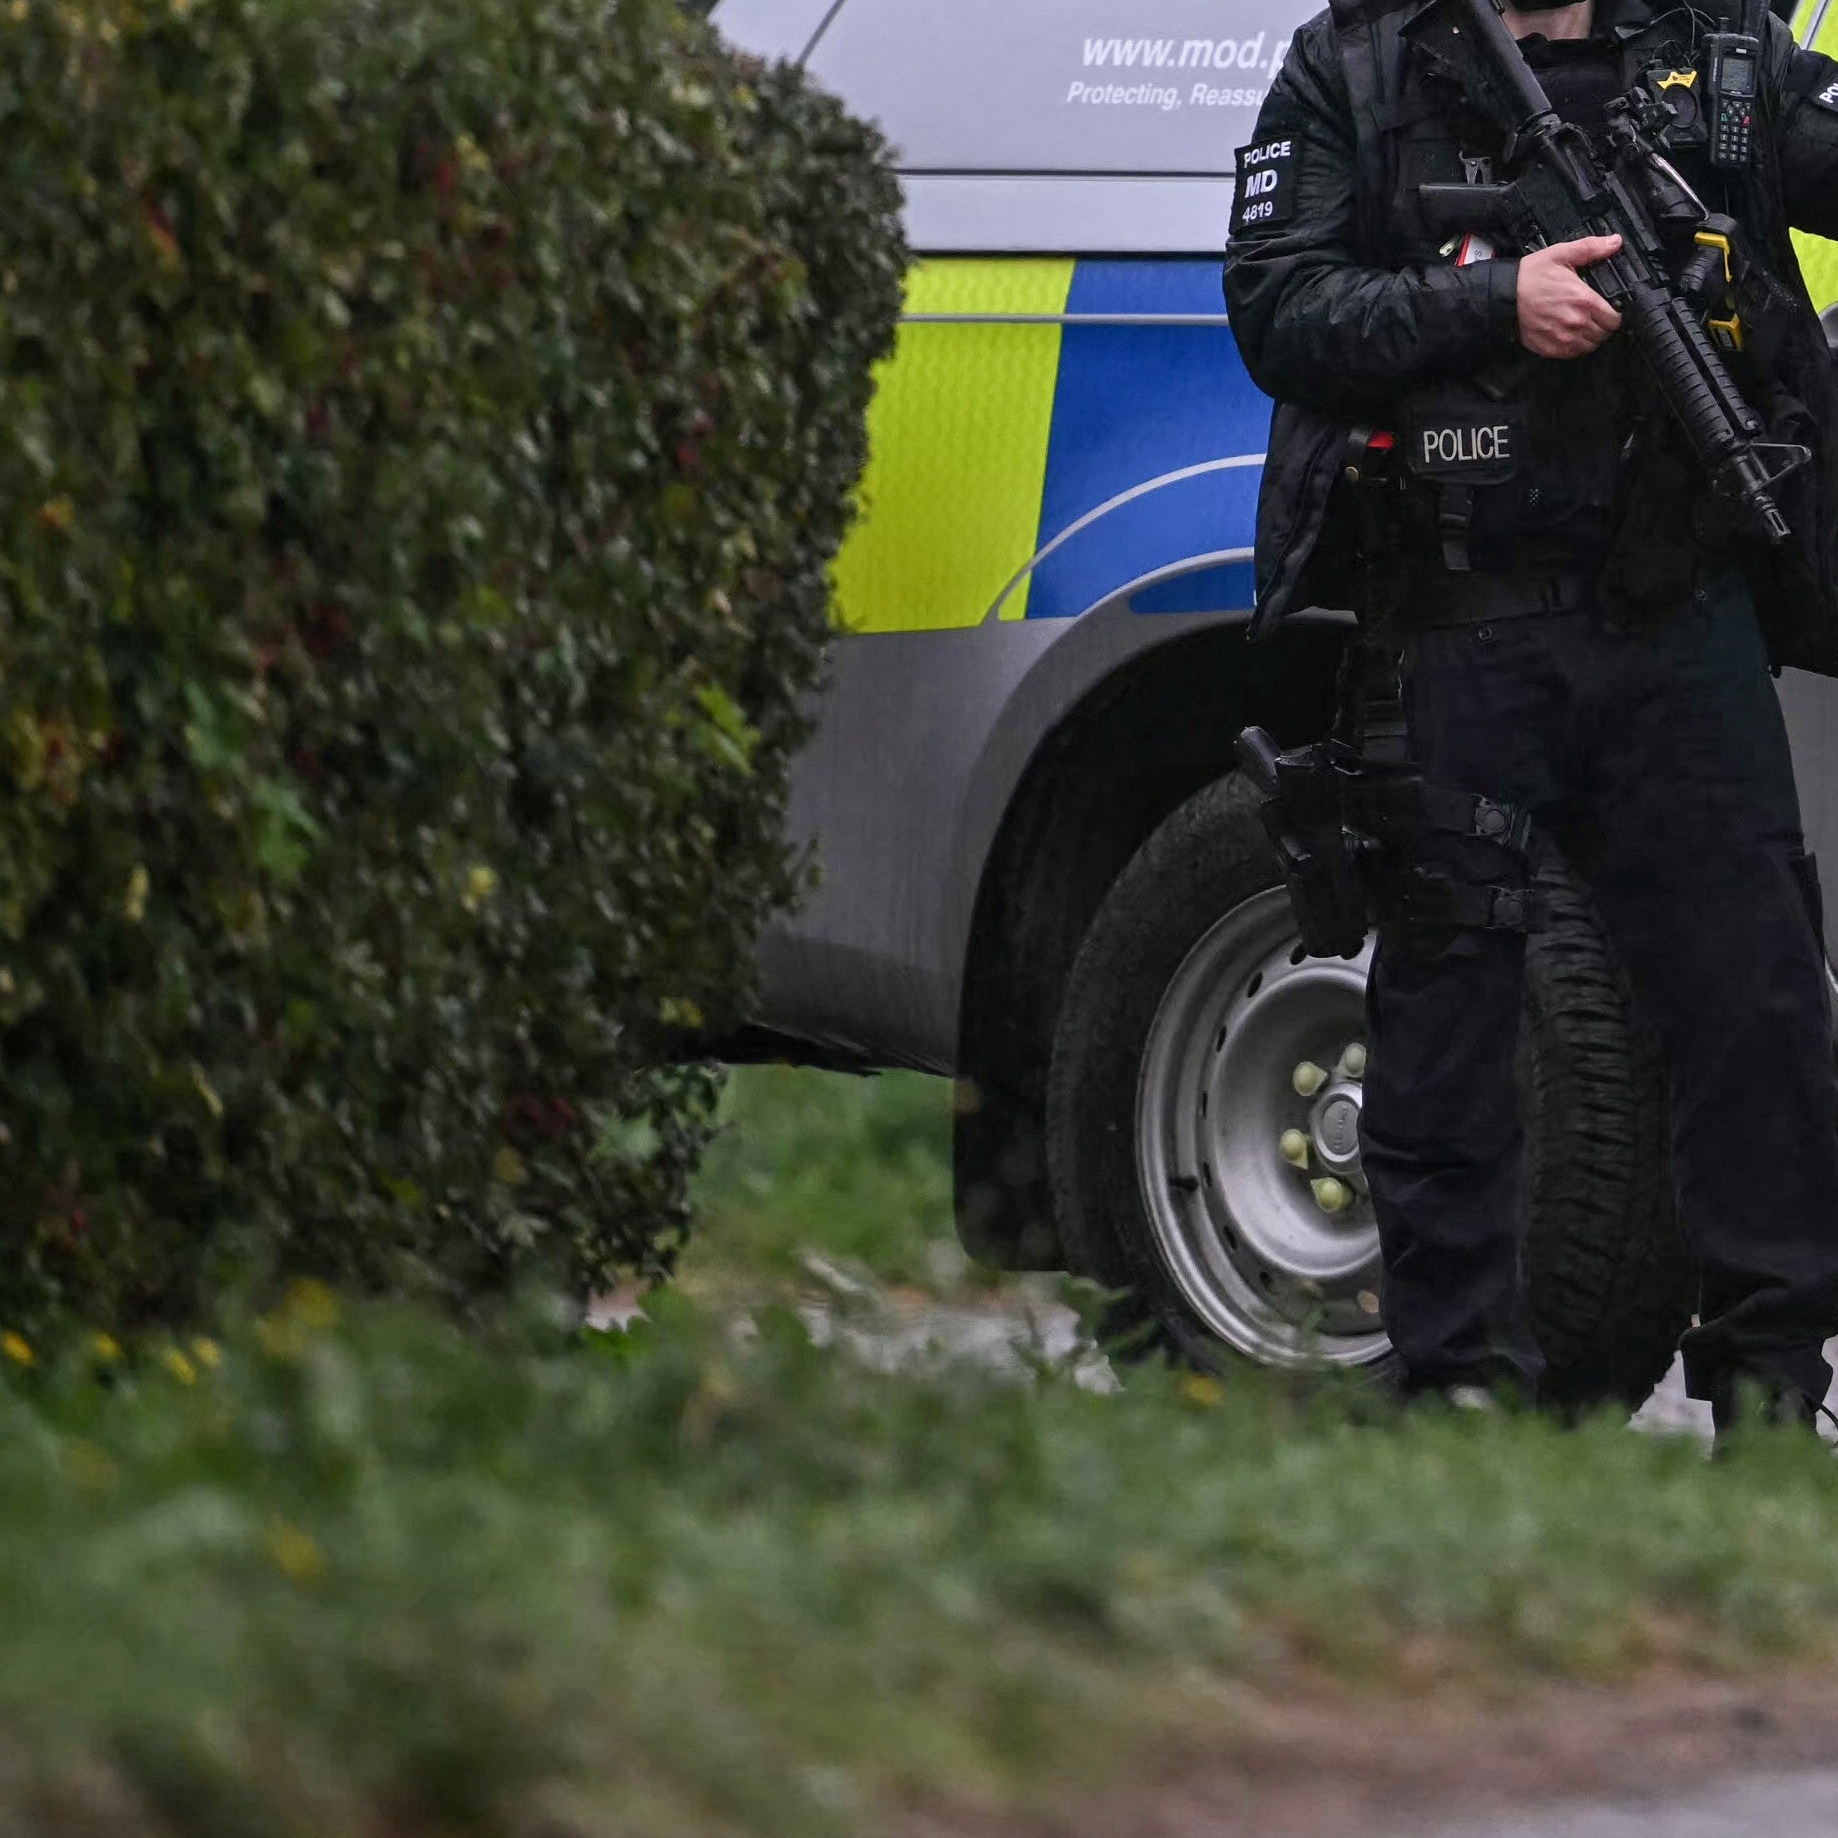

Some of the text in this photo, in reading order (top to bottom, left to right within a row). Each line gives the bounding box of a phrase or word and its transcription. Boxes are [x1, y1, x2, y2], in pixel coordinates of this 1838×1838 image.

[1066, 81, 1183, 111] Protecting,
[1243, 141, 1292, 169] POLICE
[1244, 169, 1278, 198] MD
[1242, 201, 1274, 224] 4819
[1422, 425, 1511, 464] POLICE
